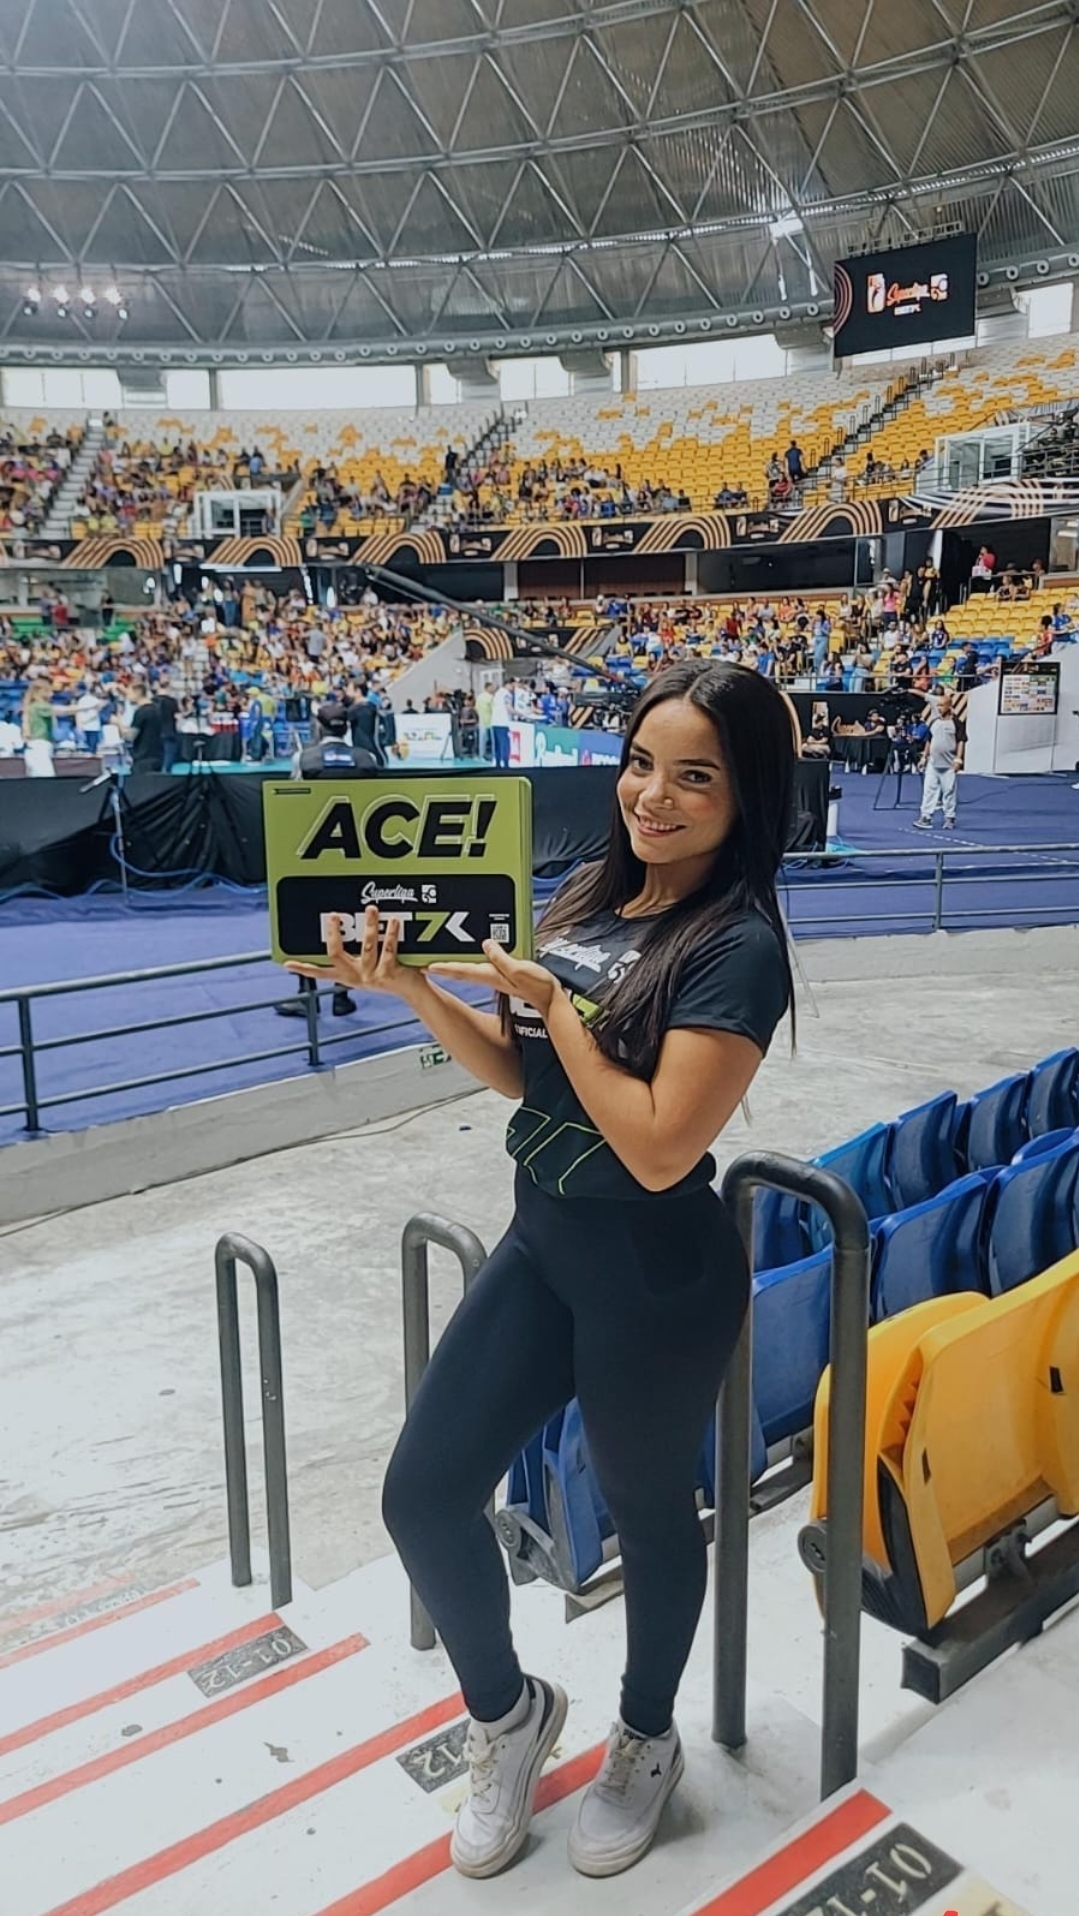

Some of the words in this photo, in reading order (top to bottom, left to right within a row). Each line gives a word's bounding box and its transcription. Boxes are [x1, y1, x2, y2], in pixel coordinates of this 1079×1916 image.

[300, 798, 498, 859] ACE!
[360, 881, 419, 905] Superliga
[201, 1637, 293, 1691] 01-12
